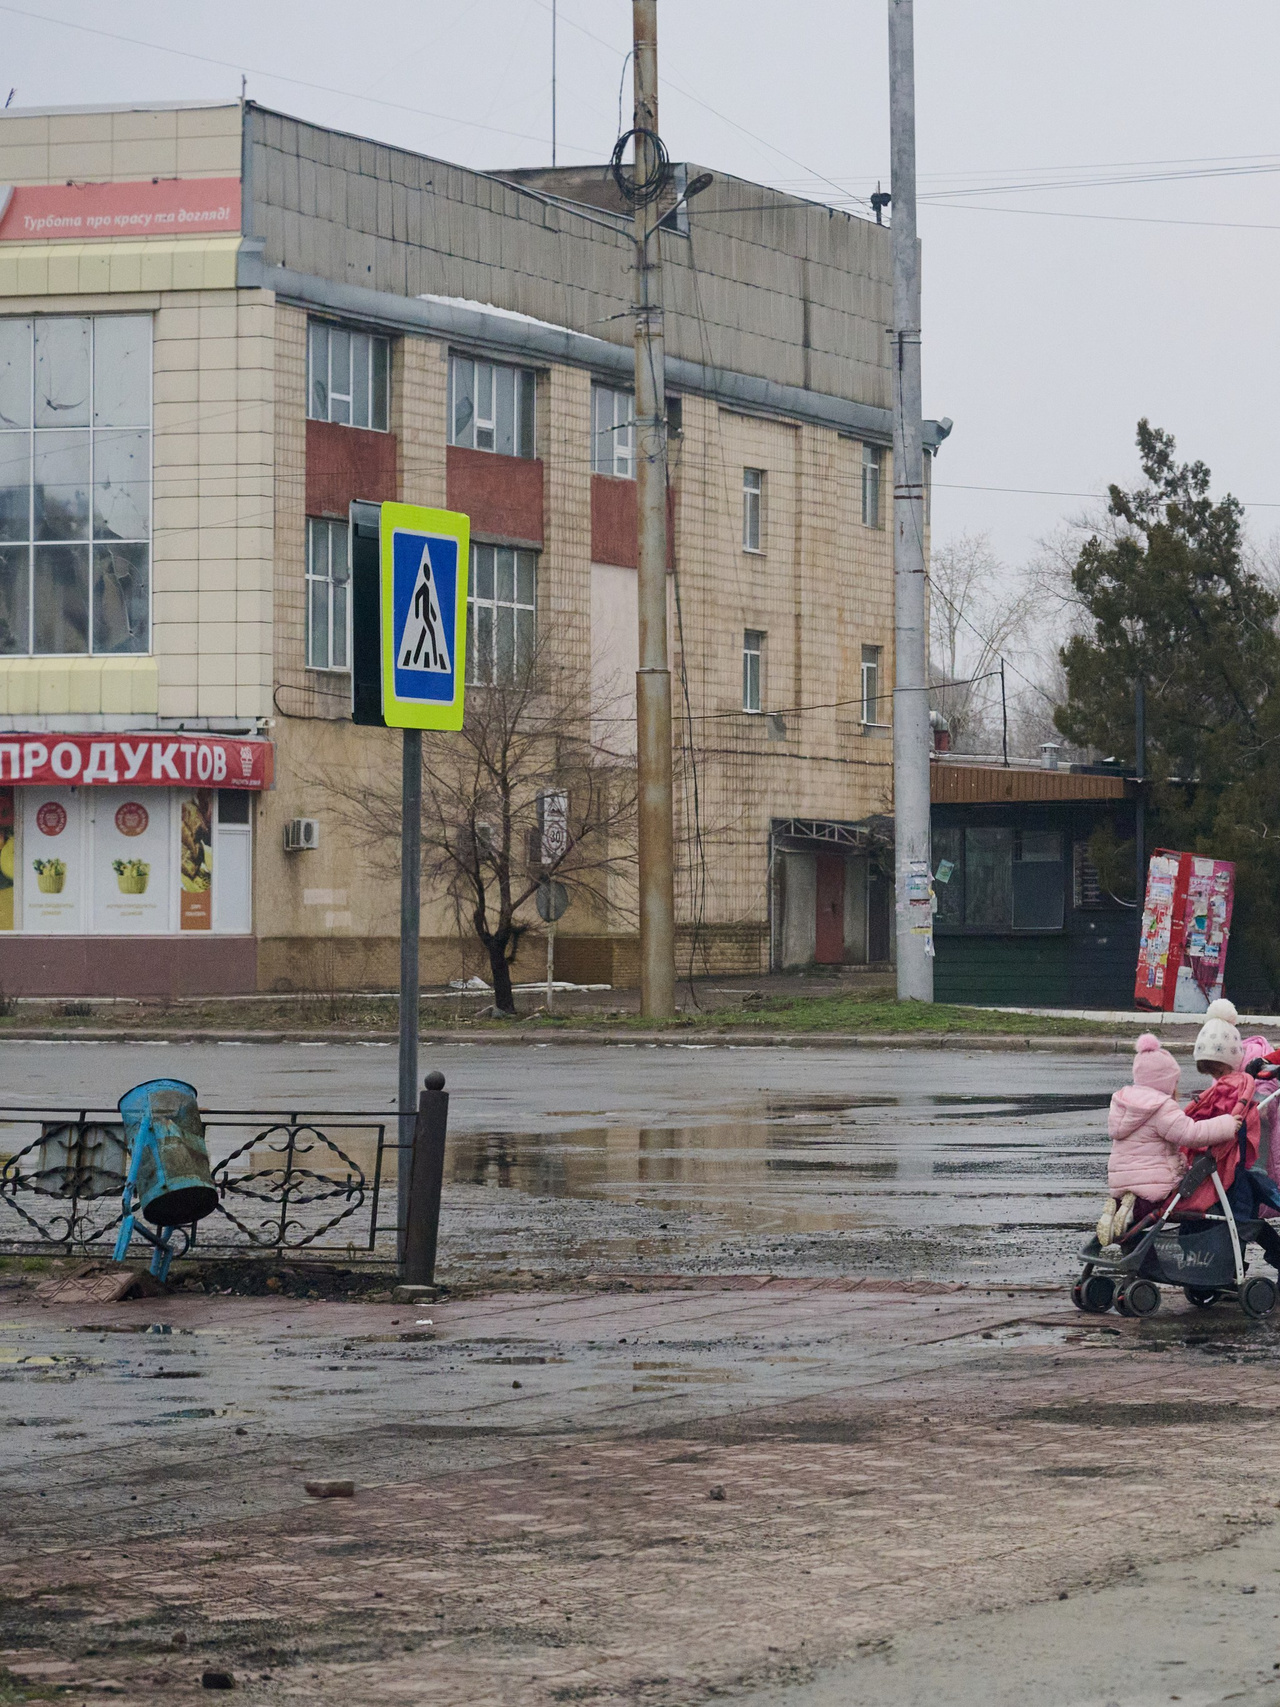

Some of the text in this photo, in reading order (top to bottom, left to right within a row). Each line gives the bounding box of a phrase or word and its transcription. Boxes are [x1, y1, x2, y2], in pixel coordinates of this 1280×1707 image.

[24, 207, 231, 231] Турбота про красу та догляд!
[0, 742, 227, 783] ПРОДУКТОВ
[550, 830, 561, 844] 30
